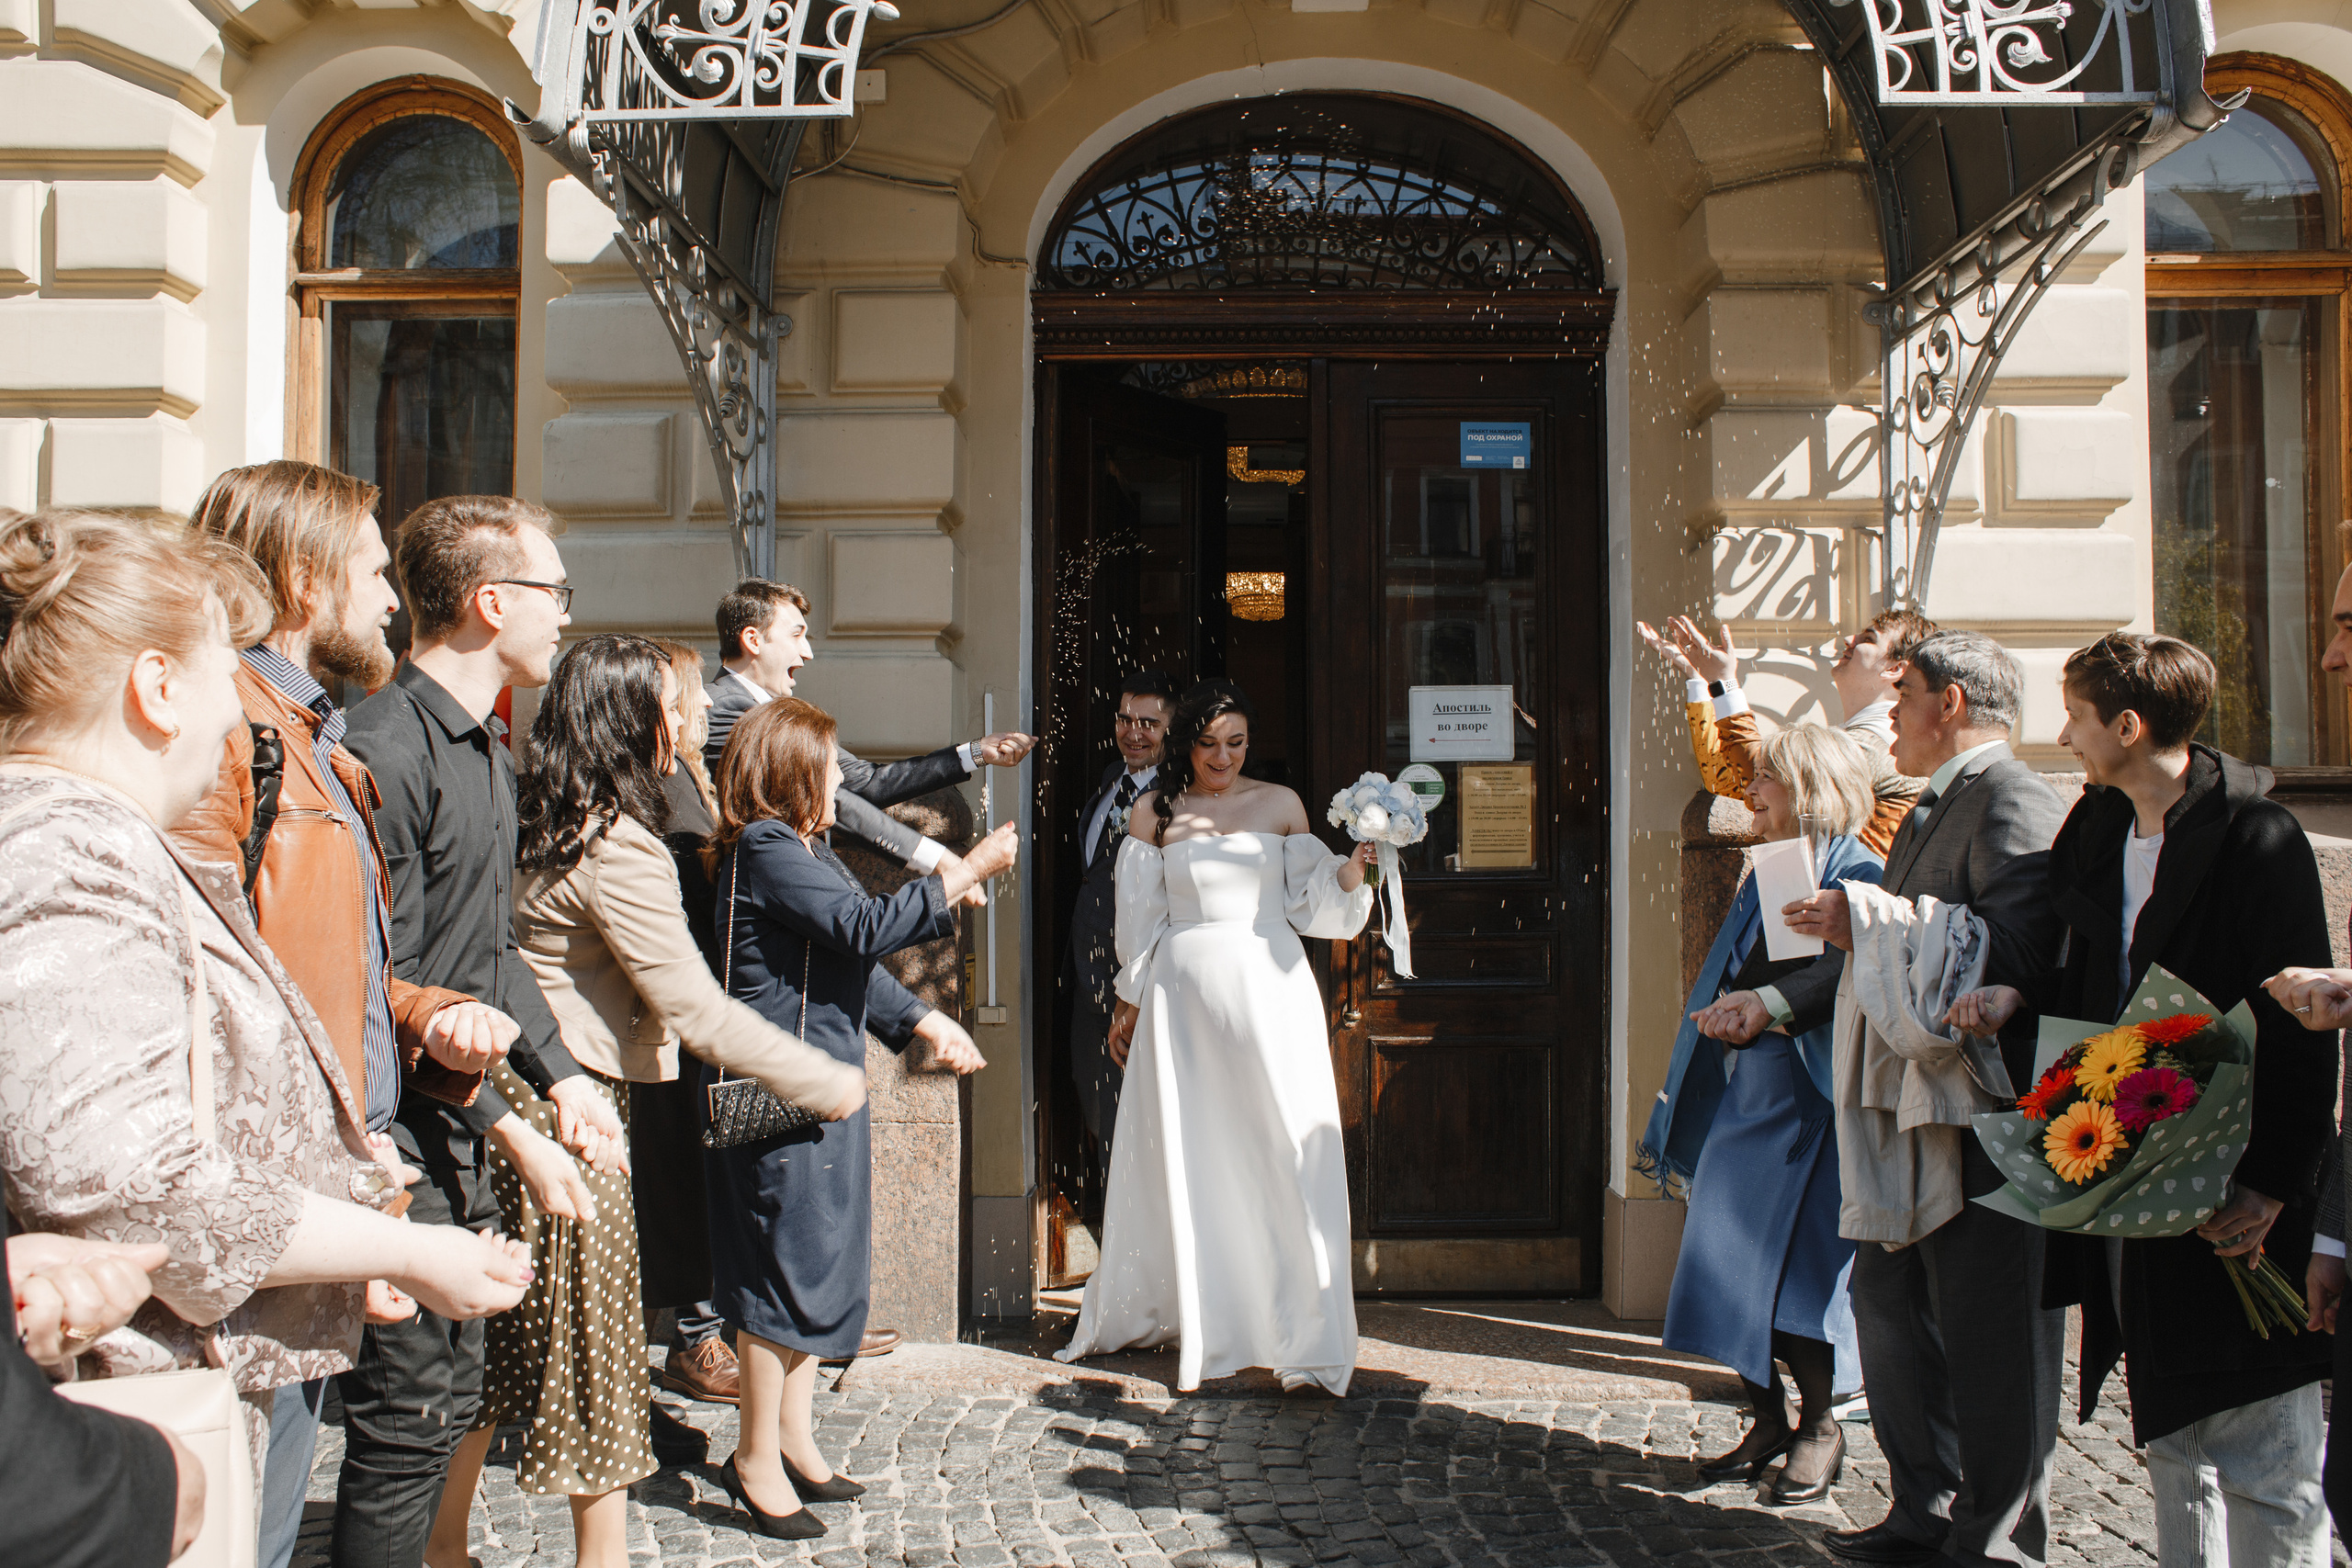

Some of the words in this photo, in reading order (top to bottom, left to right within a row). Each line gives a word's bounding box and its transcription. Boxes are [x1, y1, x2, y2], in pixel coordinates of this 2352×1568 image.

[1433, 703, 1491, 713] Апостиль
[1437, 723, 1451, 731] во
[1453, 722, 1488, 733] дворе
[1400, 766, 1420, 780] УЧАСТНИК
[1422, 766, 1440, 780] ПРОЕКТА
